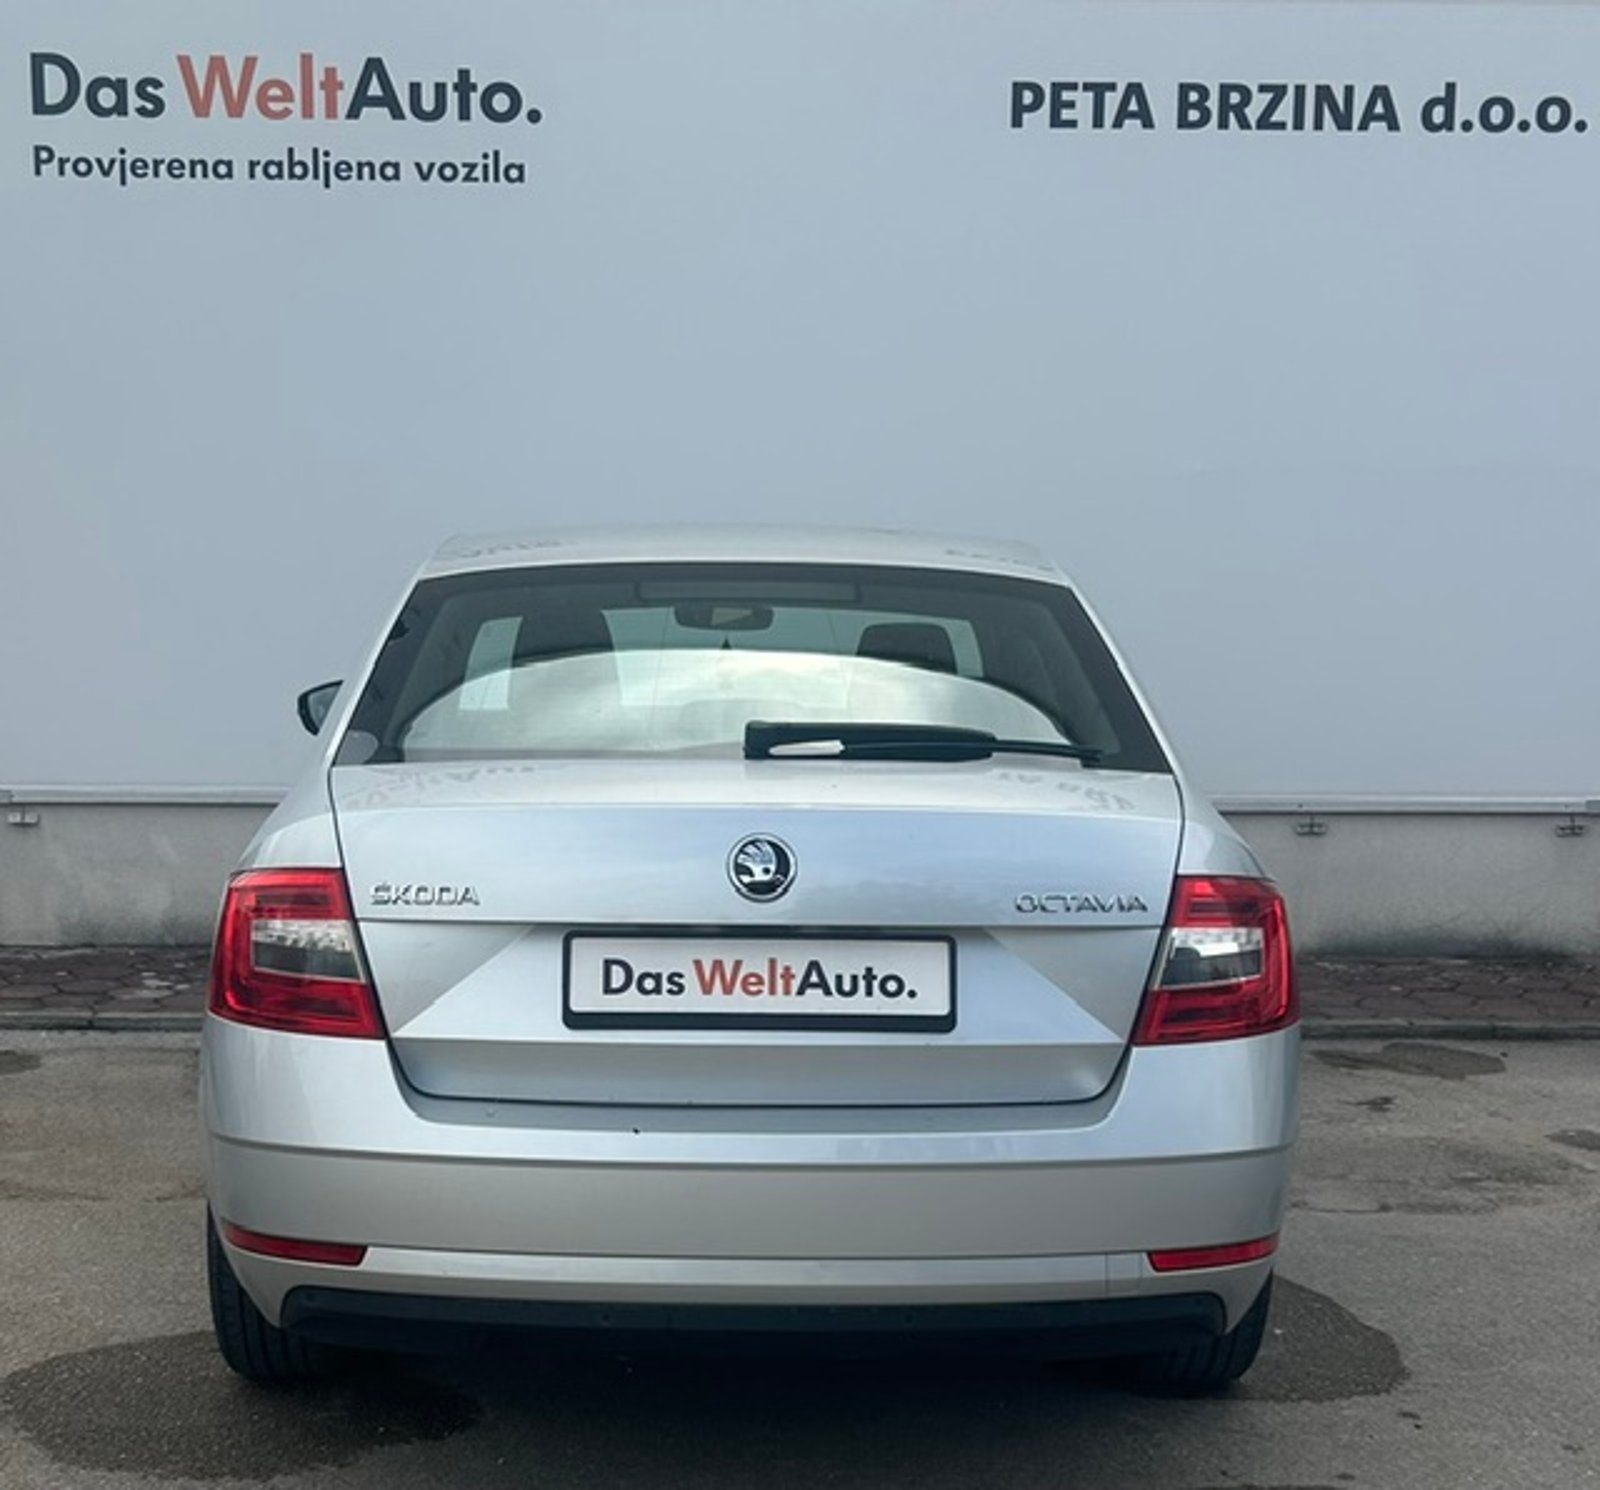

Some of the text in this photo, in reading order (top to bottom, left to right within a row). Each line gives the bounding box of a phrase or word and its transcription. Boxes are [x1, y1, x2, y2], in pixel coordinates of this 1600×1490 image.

[29, 52, 543, 124] Das WeltAuto.
[1010, 80, 1588, 133] PETA BRZINA d.o.o.
[32, 145, 526, 189] Provjerena rabljena vozila
[1015, 892, 1148, 913] OCTAVIA
[602, 957, 921, 1000] Das WeltAuto.
